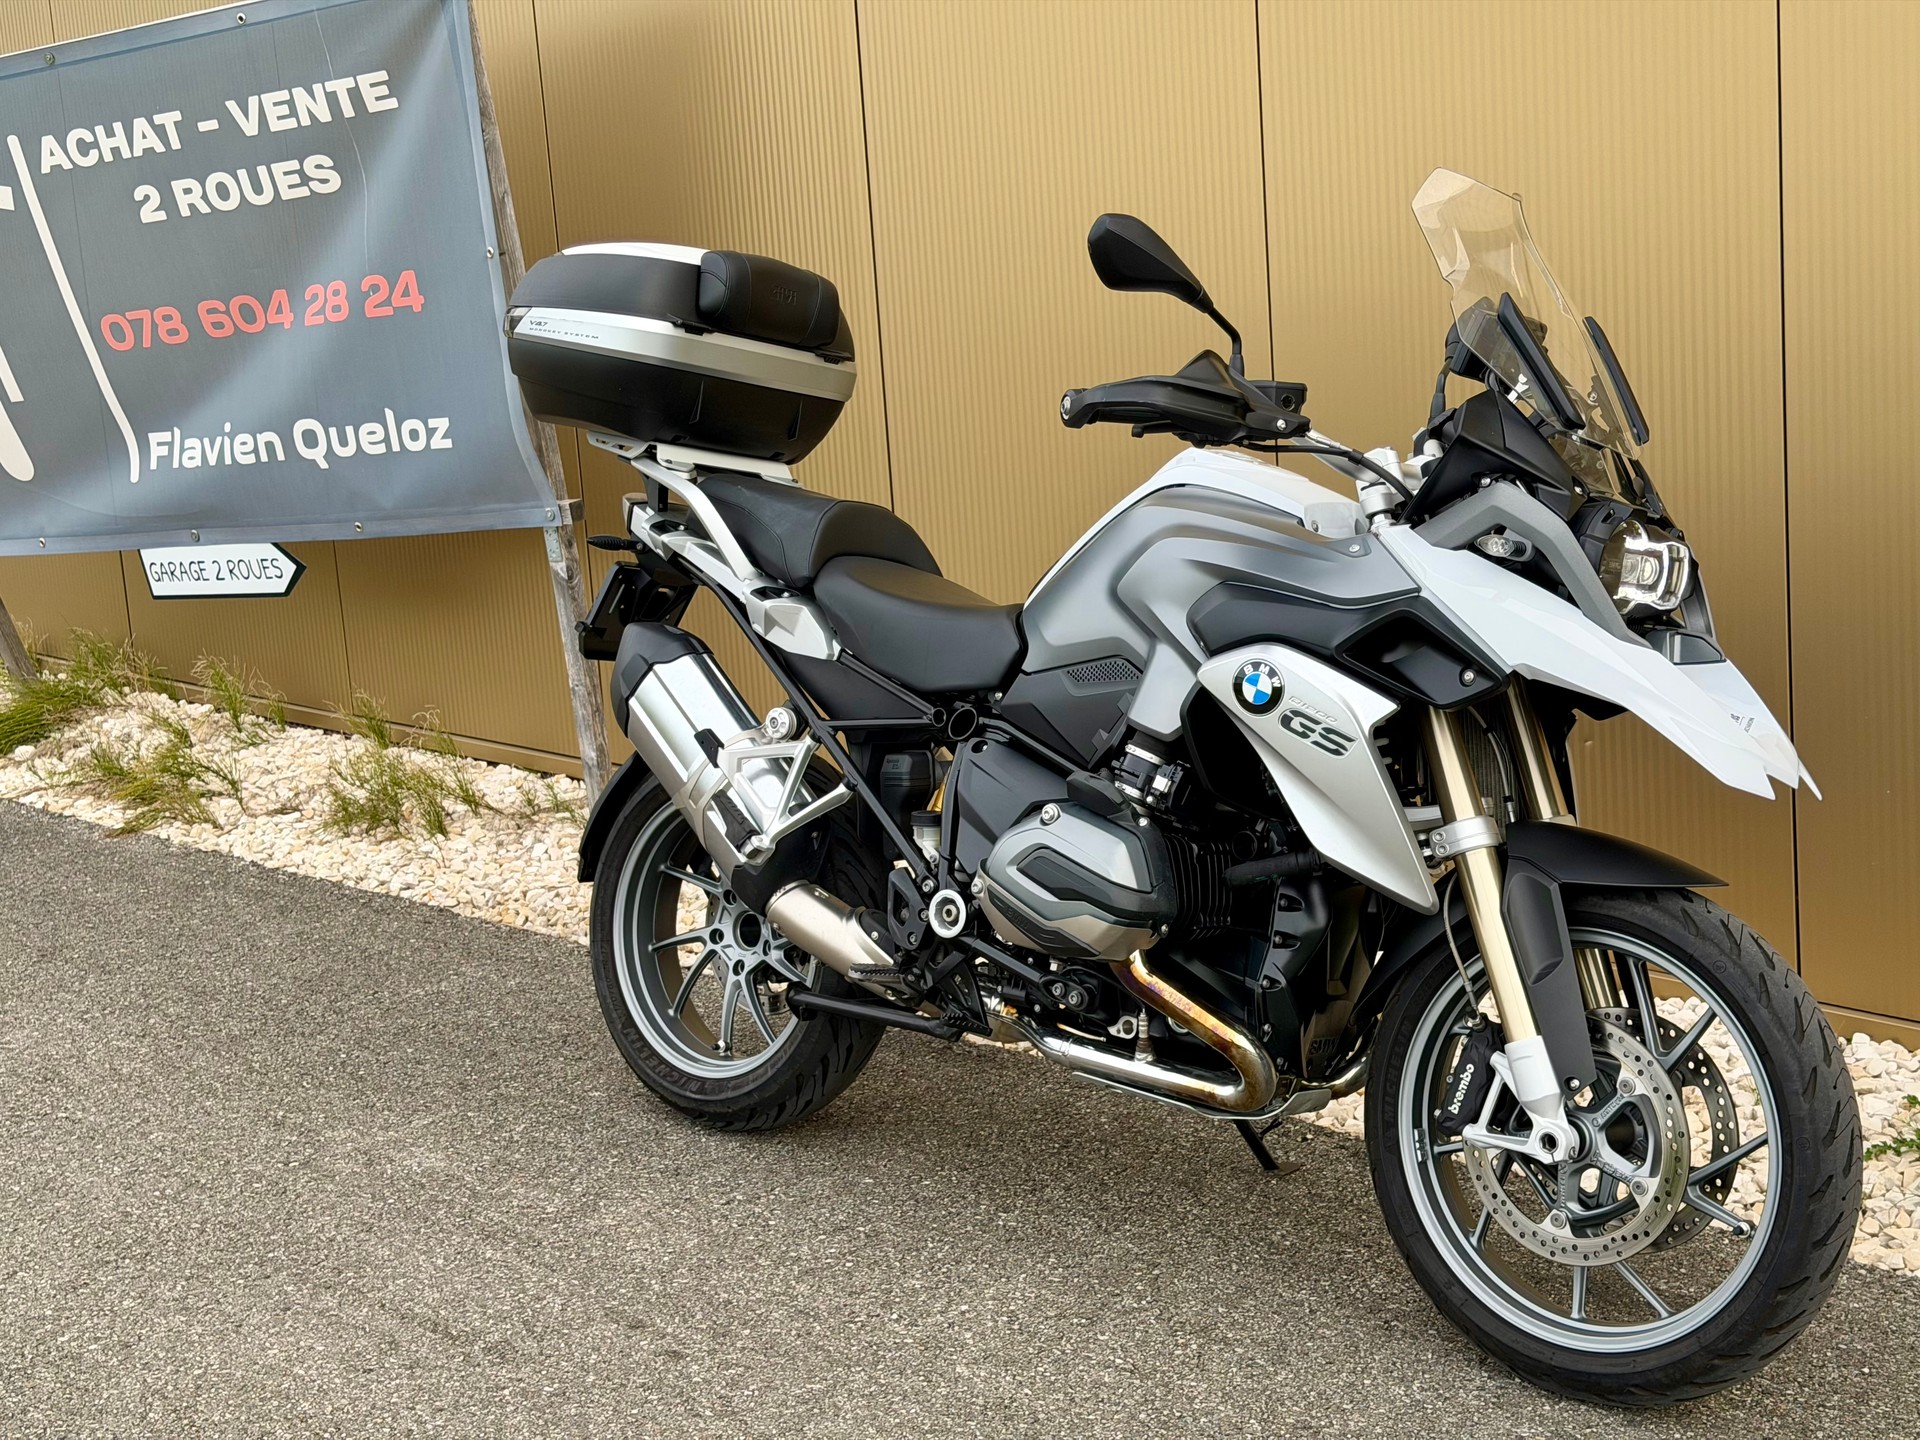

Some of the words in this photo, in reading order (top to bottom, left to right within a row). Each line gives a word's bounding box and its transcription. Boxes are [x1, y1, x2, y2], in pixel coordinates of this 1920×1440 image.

[40, 110, 183, 174] ACHAT
[197, 119, 219, 132] -
[224, 70, 399, 137] VENTE
[133, 184, 168, 224] 2
[170, 154, 342, 217] ROUES
[101, 307, 189, 351] 078
[198, 289, 294, 338] 604
[304, 281, 349, 326] 28
[361, 270, 424, 318] 24
[148, 422, 286, 470] Flavien
[293, 408, 453, 469] Queloz
[149, 560, 210, 583] GARAGE
[212, 560, 226, 581] 2
[226, 558, 284, 581] ROUES
[1243, 663, 1282, 688] BMW
[1280, 709, 1356, 756] GS
[623, 1027, 703, 1094] MICHELIN
[1447, 1063, 1475, 1115] brembo
